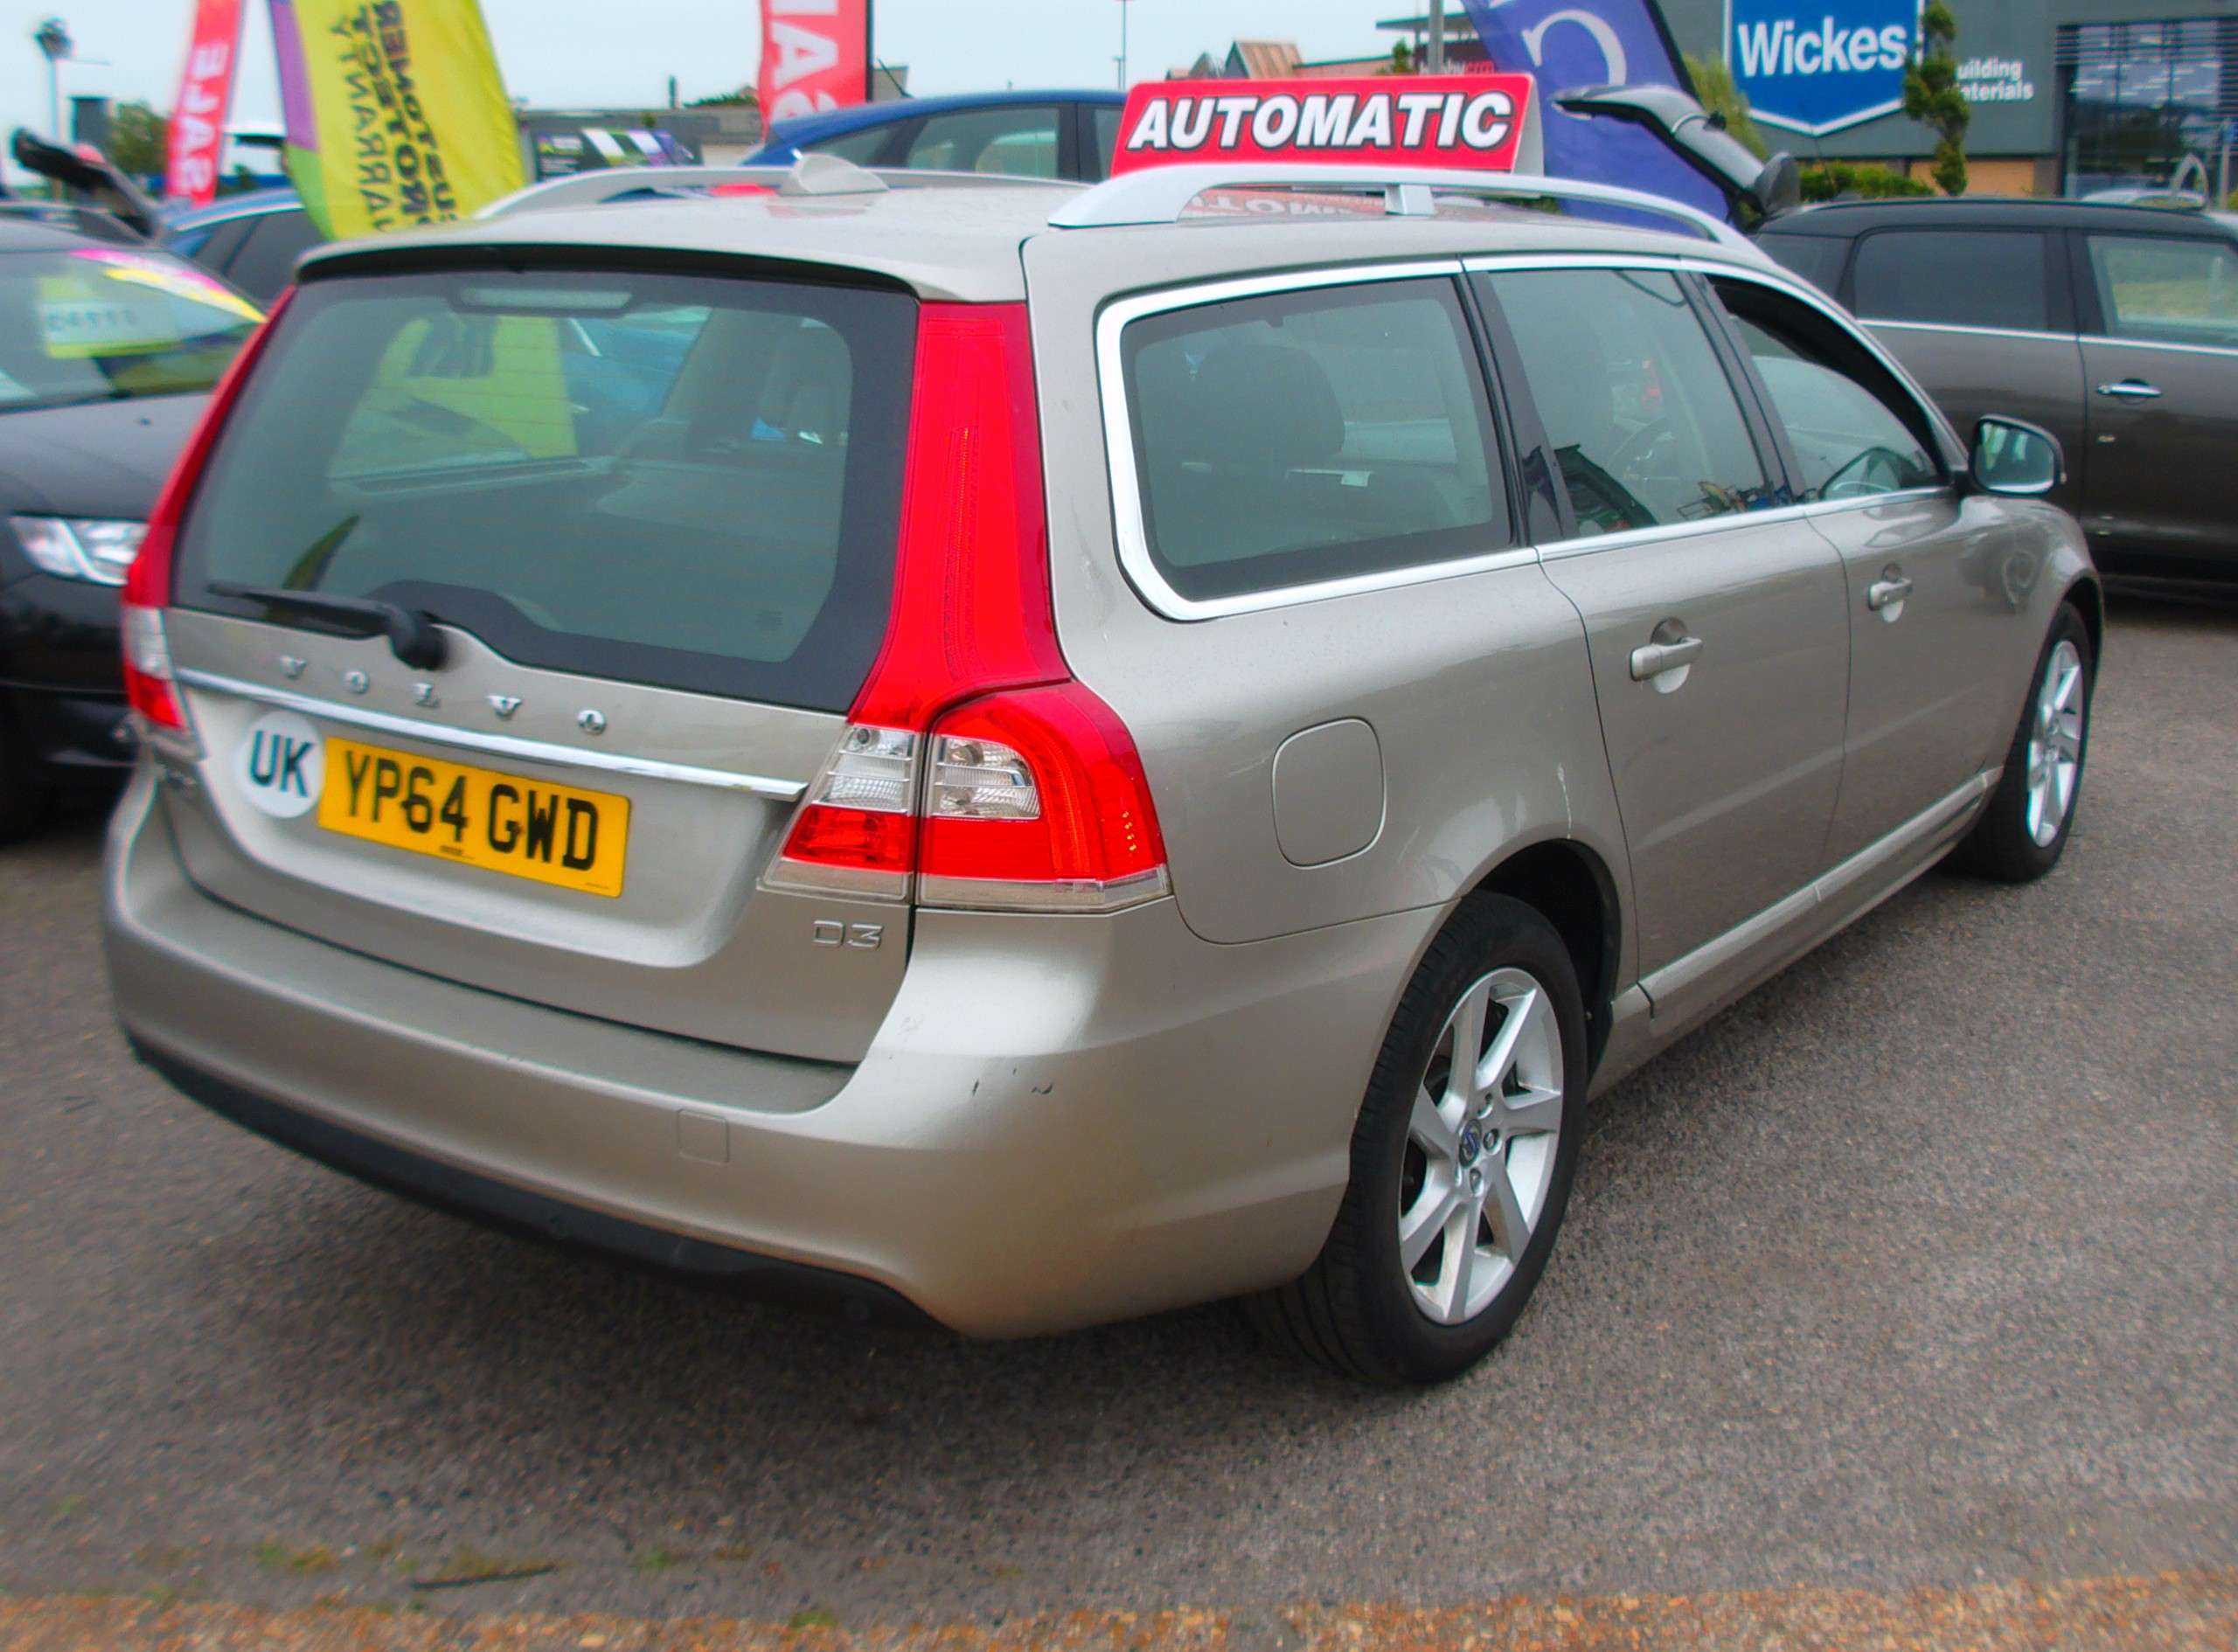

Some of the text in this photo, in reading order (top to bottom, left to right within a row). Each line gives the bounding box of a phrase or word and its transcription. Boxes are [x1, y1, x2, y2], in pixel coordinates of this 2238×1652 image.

[1737, 15, 1908, 78] Wickes
[1957, 57, 2022, 81] uilding
[1126, 91, 1514, 151] AUTOMATIC
[1955, 80, 2033, 101] aterials
[279, 655, 608, 735] VOLVO
[249, 729, 315, 799] UK
[345, 749, 599, 871] YP64 GWD
[811, 919, 885, 951] D3
